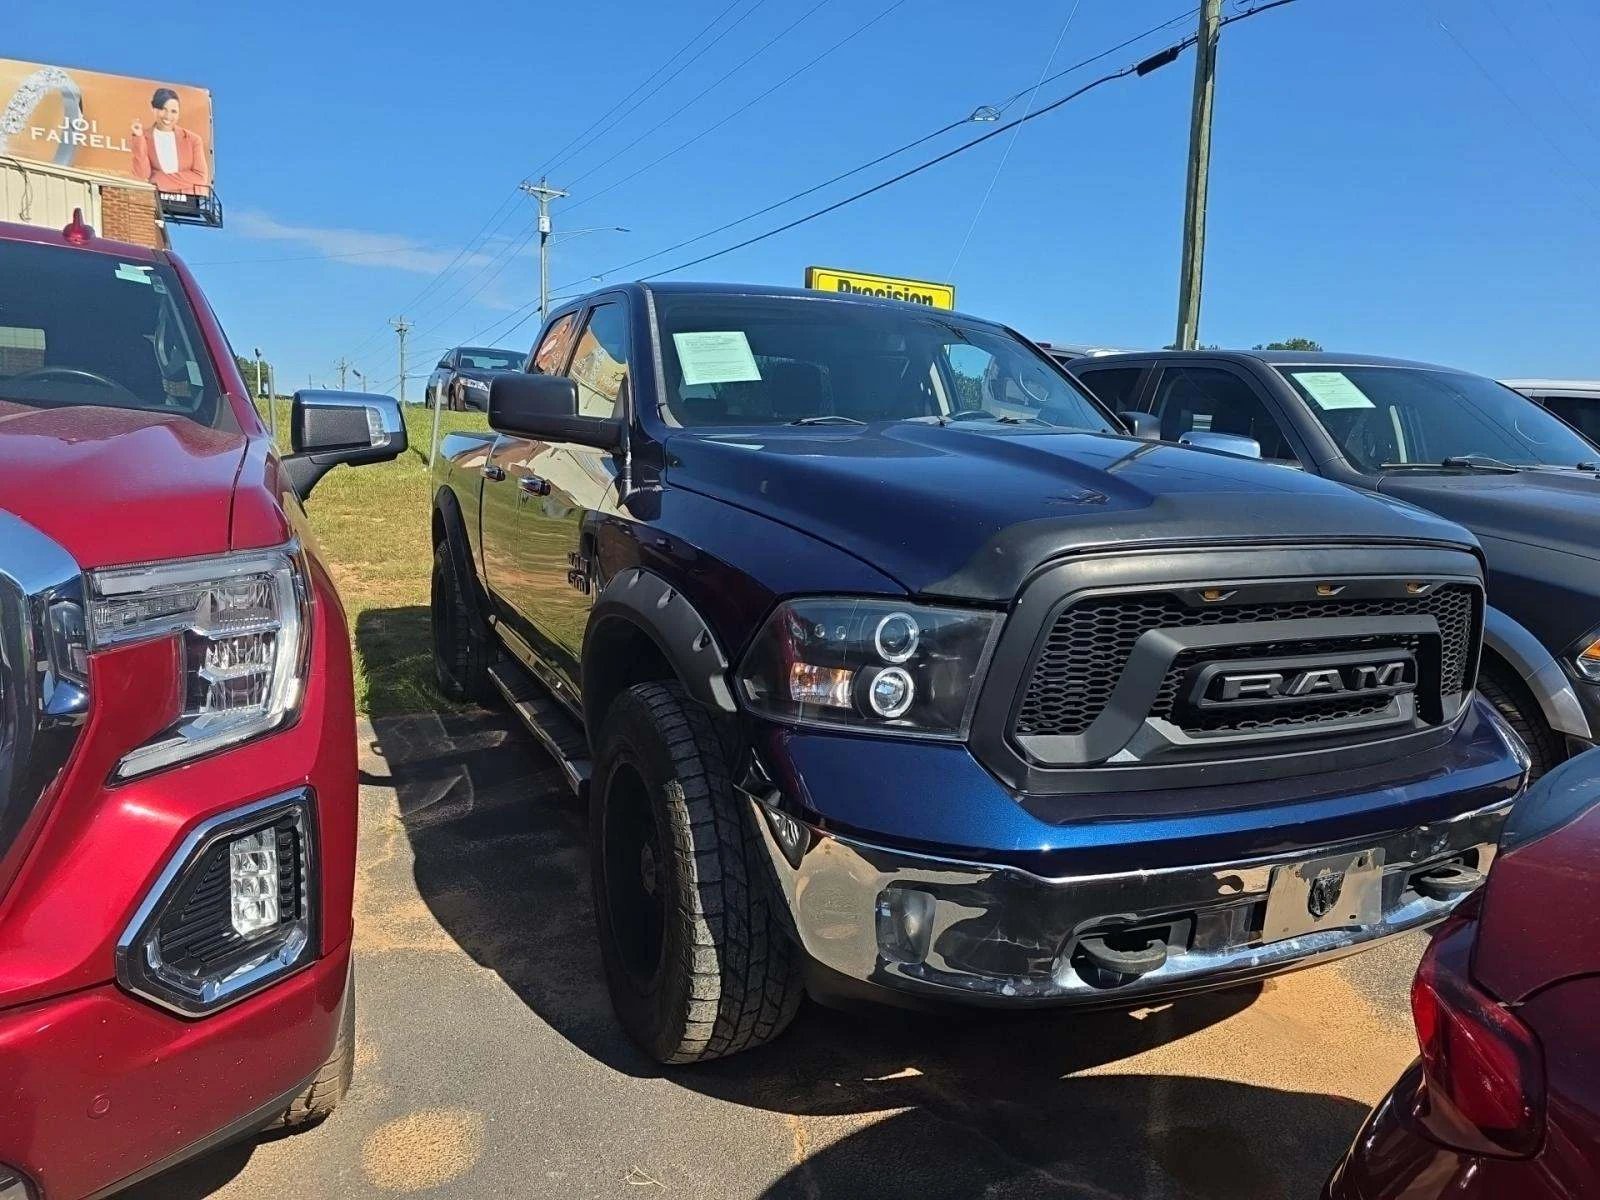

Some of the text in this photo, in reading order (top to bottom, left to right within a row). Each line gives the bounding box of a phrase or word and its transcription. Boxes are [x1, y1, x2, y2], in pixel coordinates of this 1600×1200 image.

[58, 115, 97, 133] JOI
[31, 127, 132, 152] FAIRELL
[1223, 662, 1404, 699] RAM
